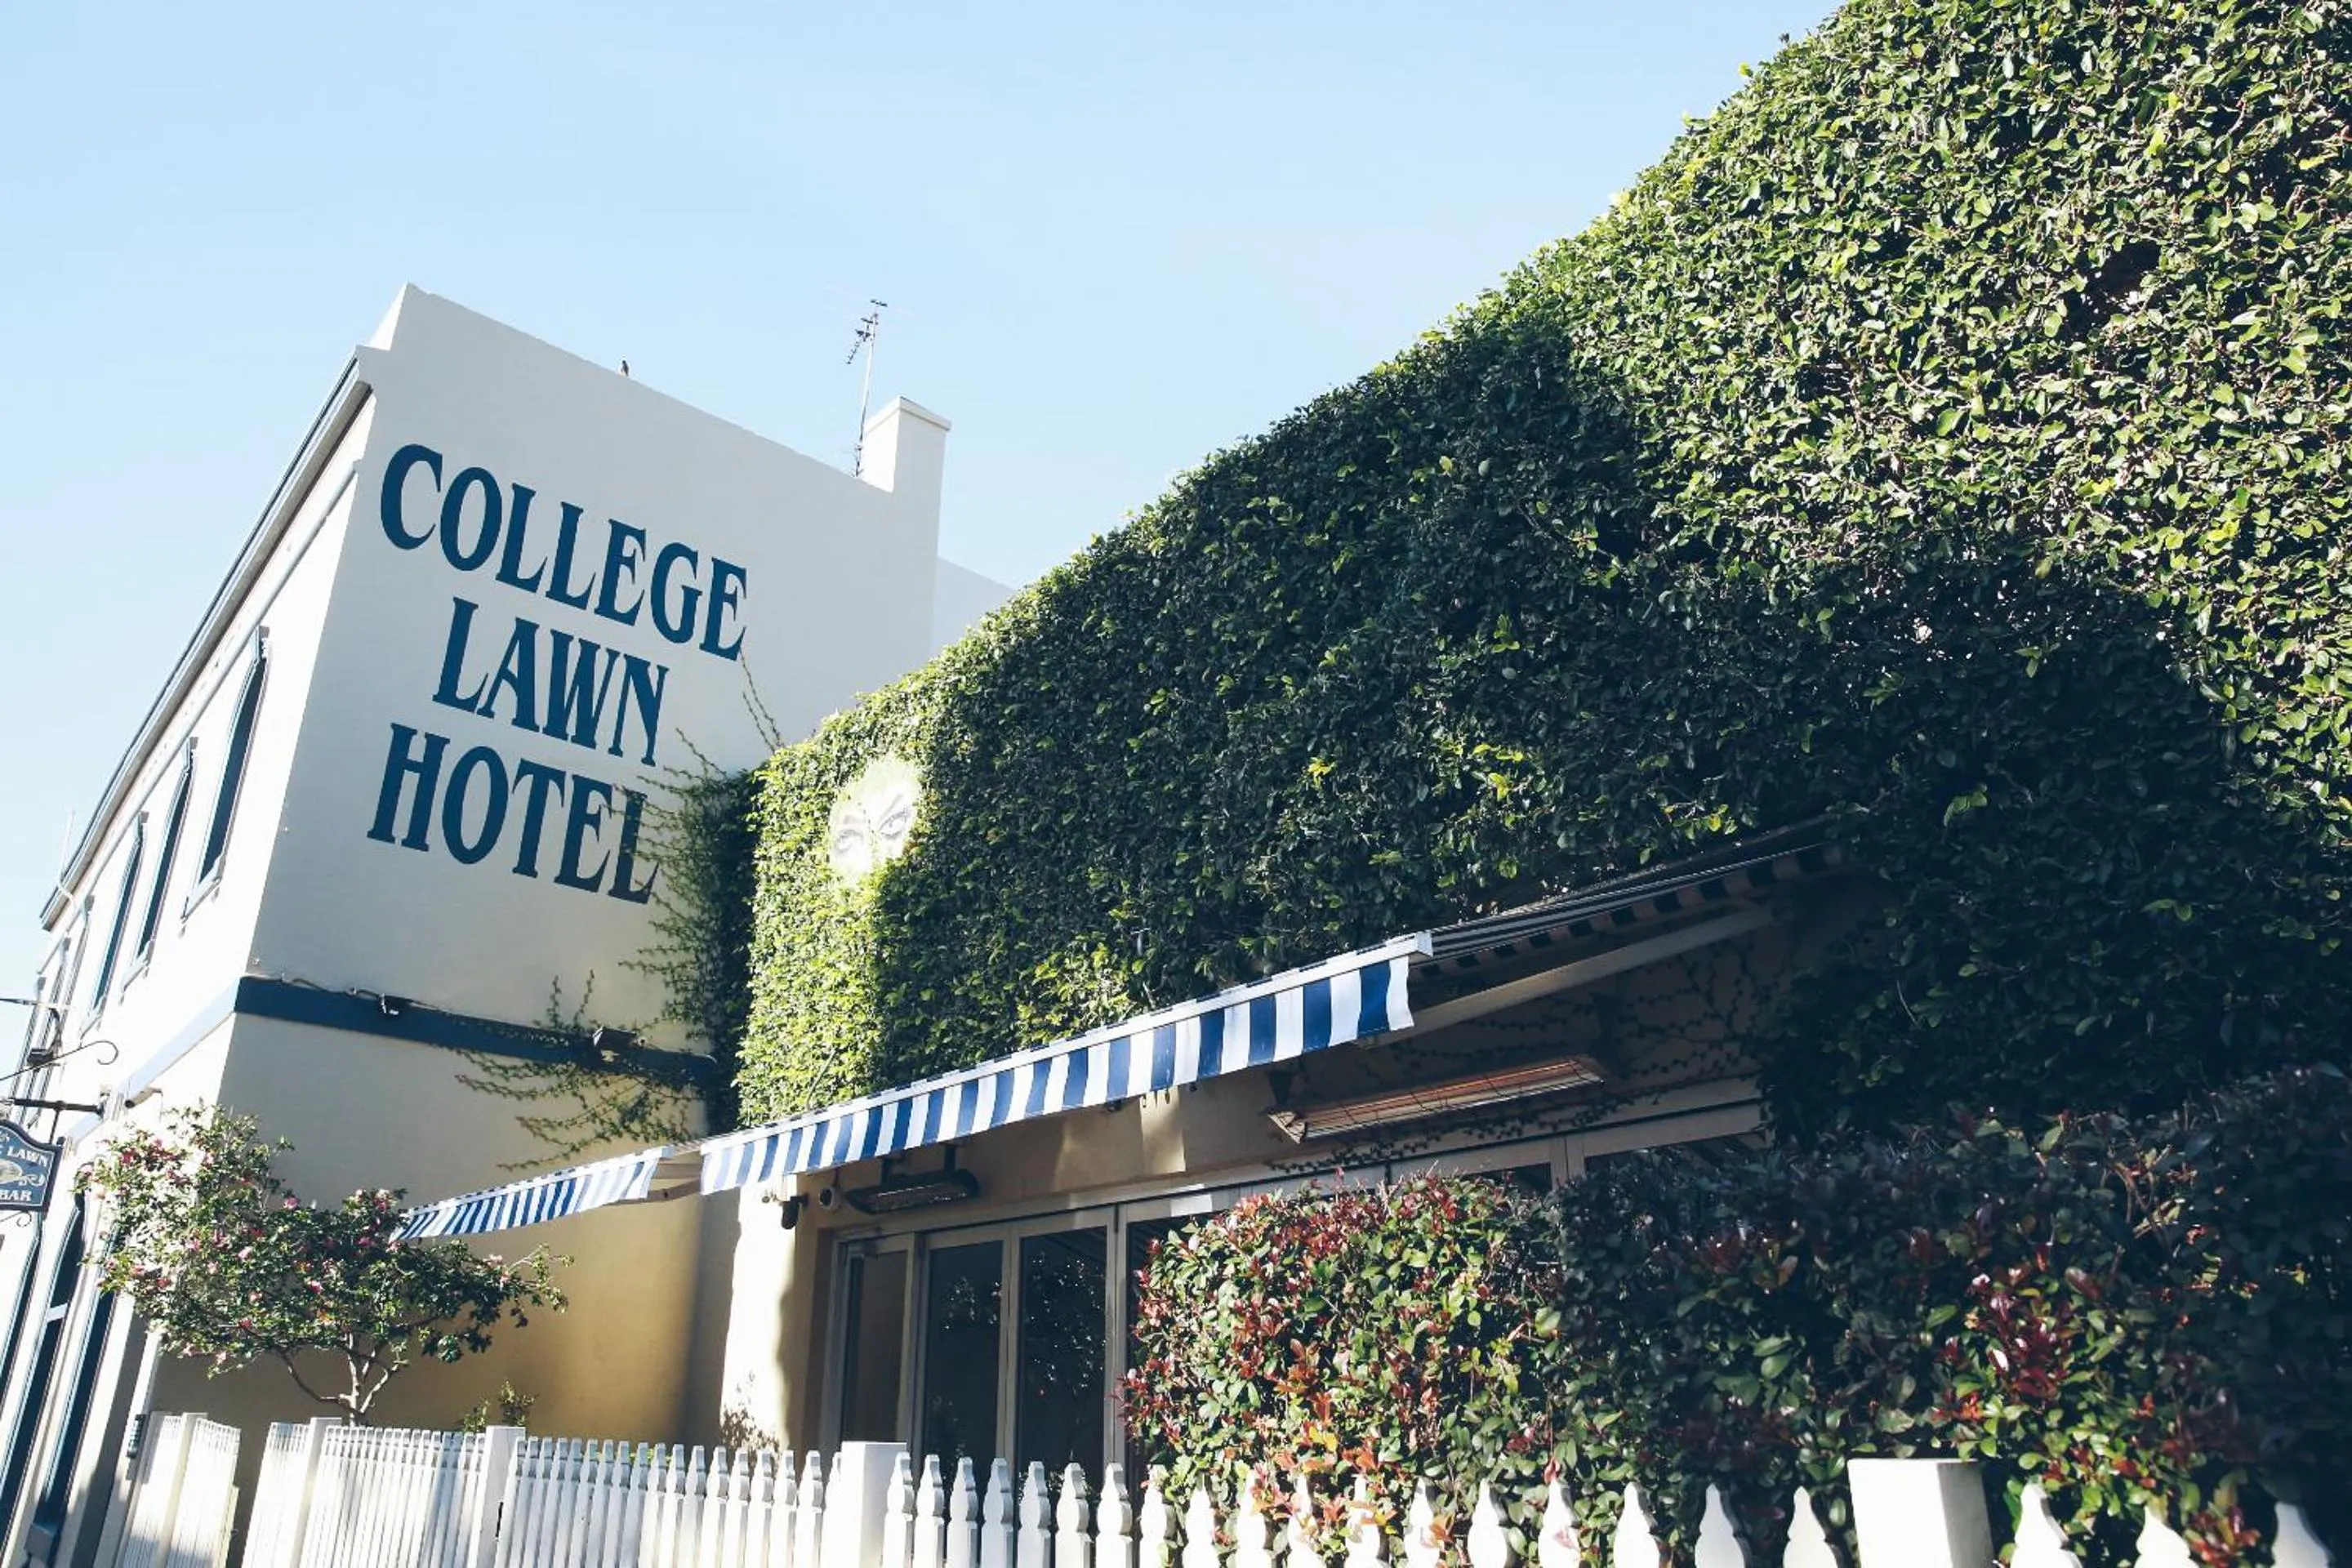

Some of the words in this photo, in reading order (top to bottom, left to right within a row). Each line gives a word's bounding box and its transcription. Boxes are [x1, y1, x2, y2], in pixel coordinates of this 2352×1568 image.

[381, 443, 746, 662] COLLEGE
[433, 596, 670, 766] LAWN
[367, 722, 662, 904] HOTEL
[7, 1146, 48, 1167] LAWN
